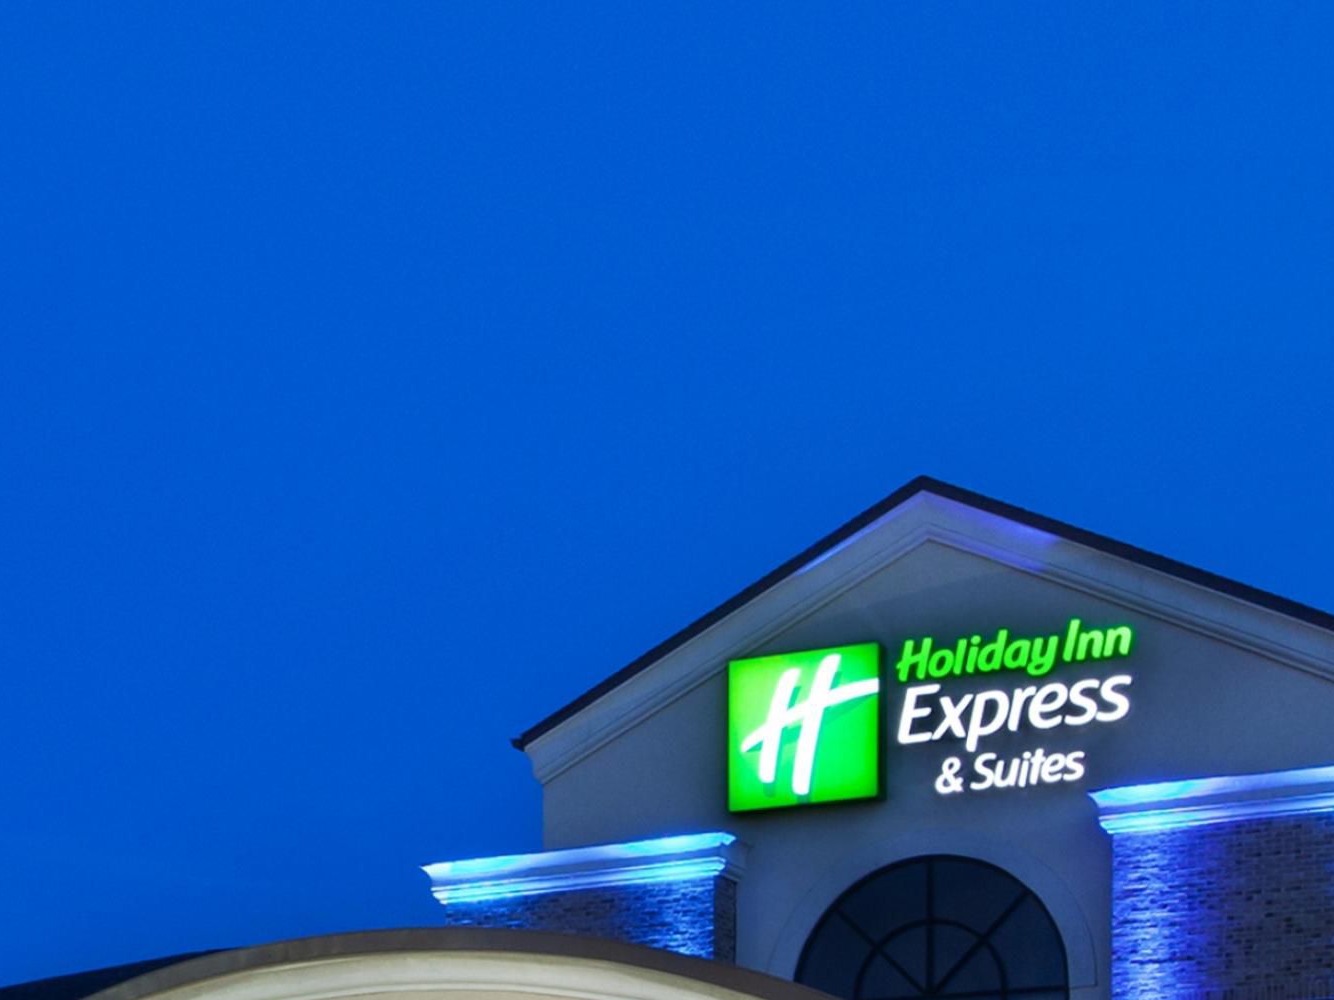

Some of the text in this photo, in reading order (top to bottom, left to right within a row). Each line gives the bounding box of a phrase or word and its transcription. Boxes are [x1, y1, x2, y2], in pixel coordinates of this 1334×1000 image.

[896, 618, 1133, 682] Holiday Inn
[897, 674, 1133, 752] Express
[934, 748, 1085, 794] & Suites
